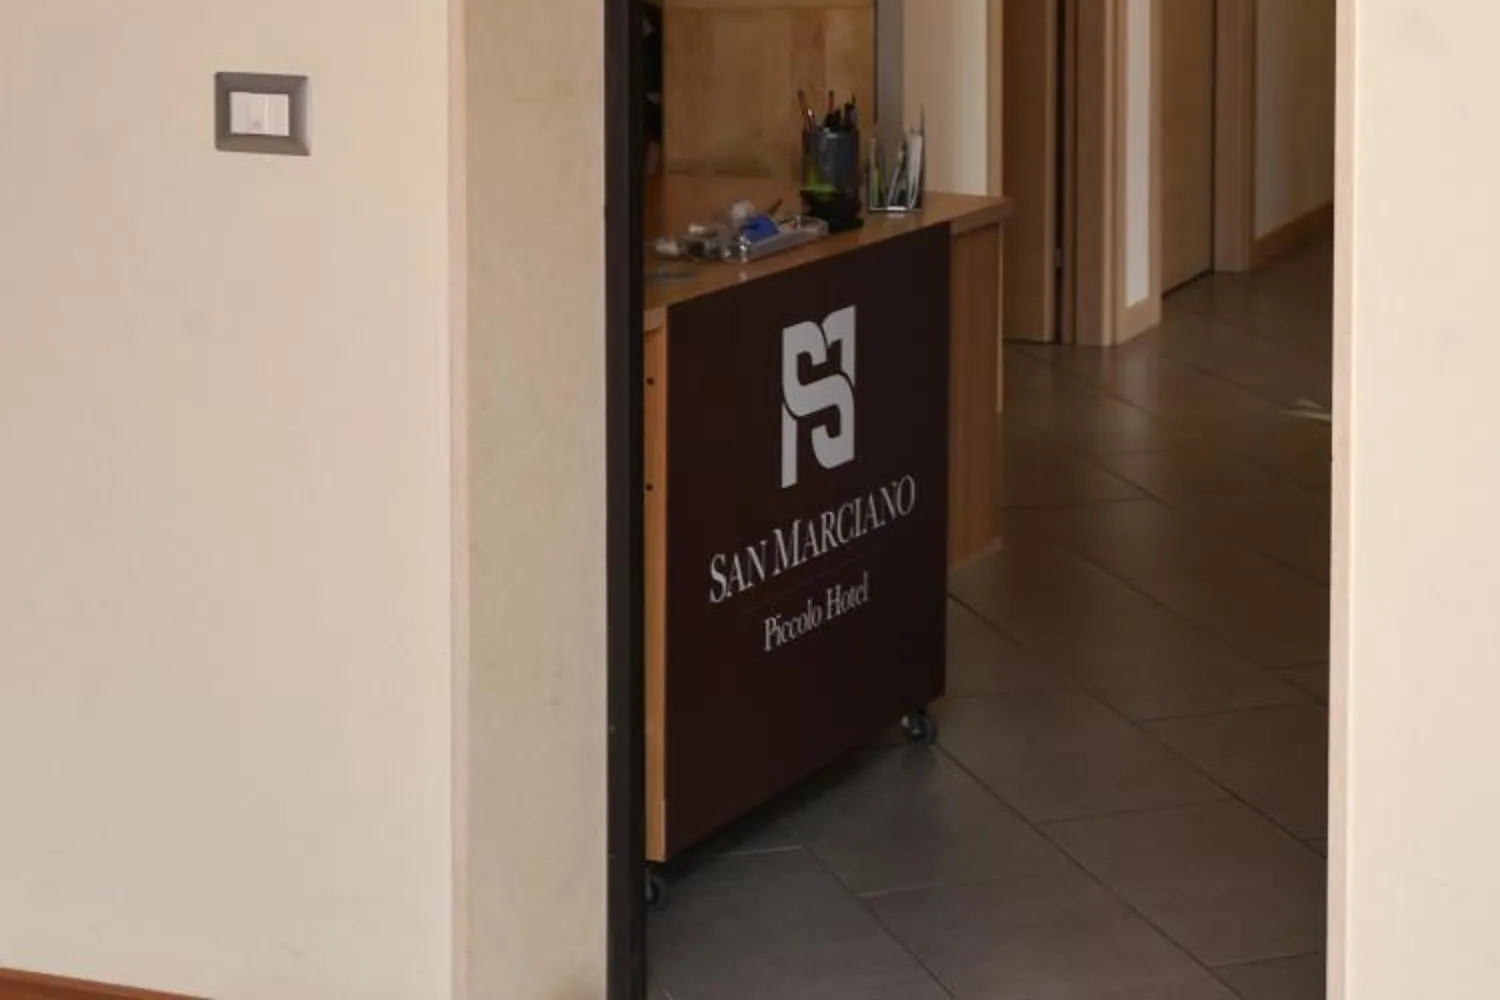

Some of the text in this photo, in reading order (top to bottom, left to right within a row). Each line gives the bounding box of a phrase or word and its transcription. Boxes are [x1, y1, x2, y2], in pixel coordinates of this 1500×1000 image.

[710, 475, 915, 603] SAN MARCIANO
[764, 571, 869, 652] Piccolo Hotel
